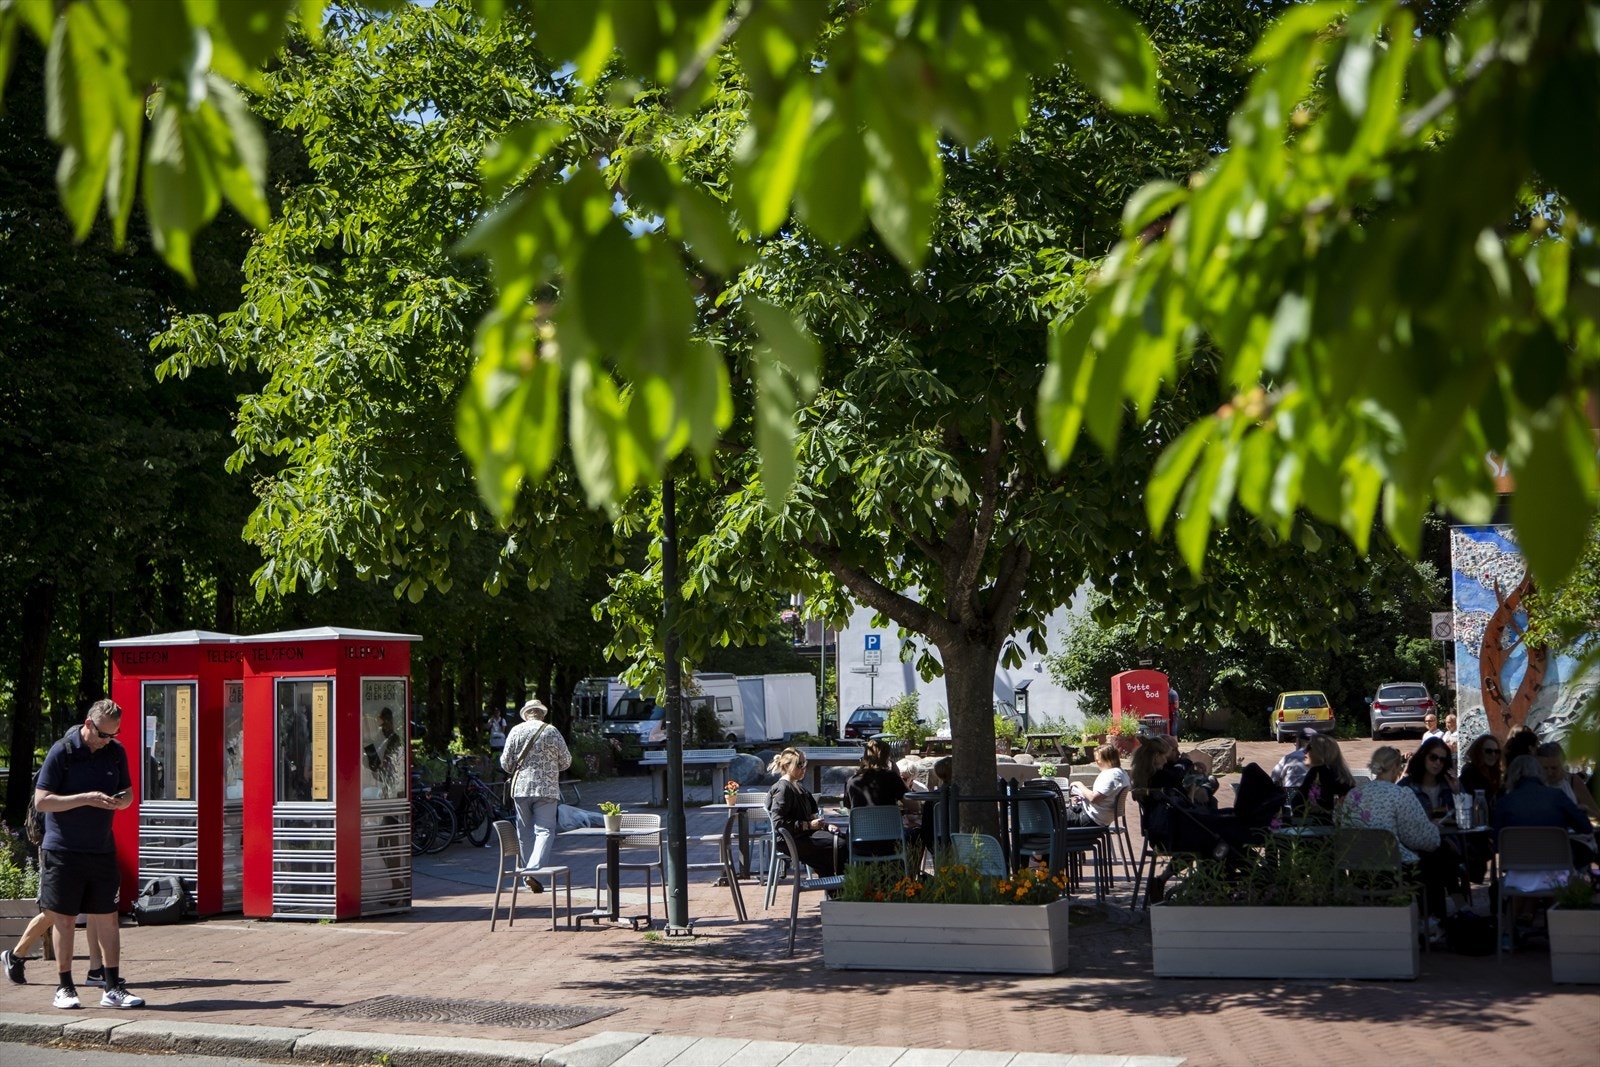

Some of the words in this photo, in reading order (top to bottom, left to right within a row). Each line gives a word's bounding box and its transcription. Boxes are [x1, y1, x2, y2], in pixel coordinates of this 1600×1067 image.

[868, 636, 877, 649] P
[121, 651, 168, 664] TELEFON
[207, 650, 243, 662] TELEFO
[252, 648, 304, 661] TELEFON
[344, 646, 385, 660] TELEFON
[1126, 683, 1150, 693] Bytte
